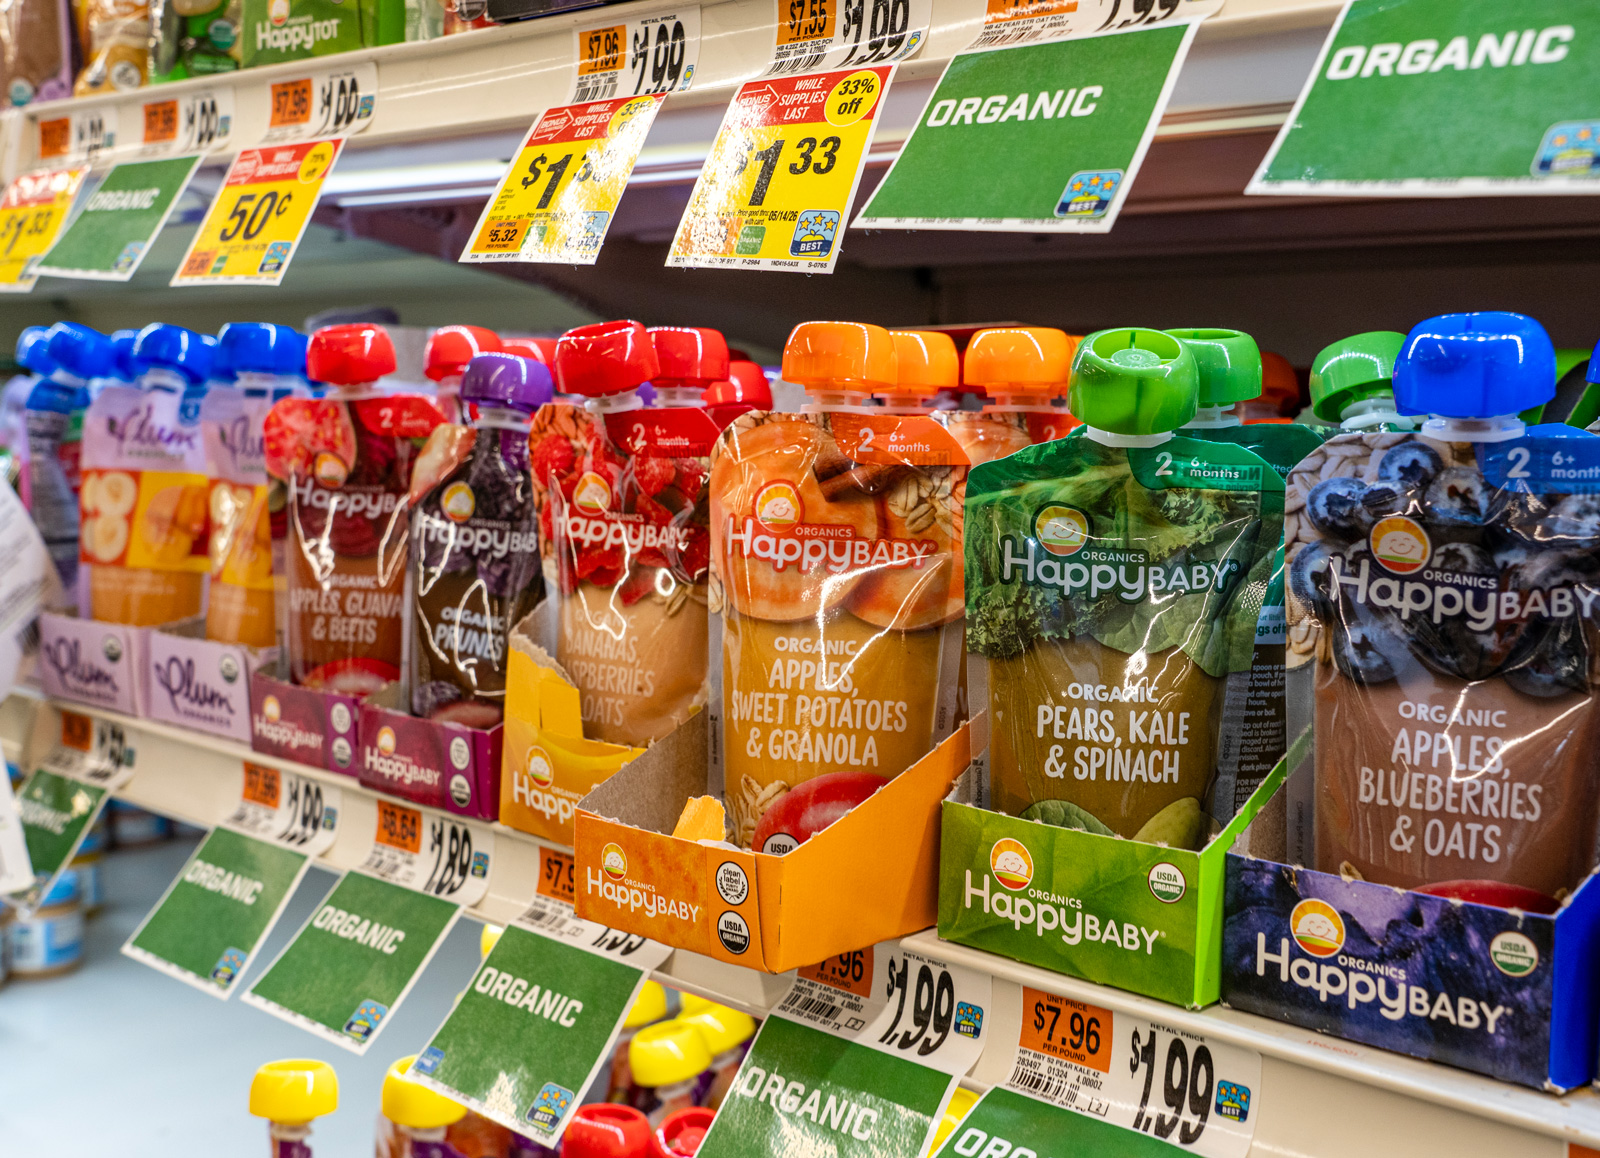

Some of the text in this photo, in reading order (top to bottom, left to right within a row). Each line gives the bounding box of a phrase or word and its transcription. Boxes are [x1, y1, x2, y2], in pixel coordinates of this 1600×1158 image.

[790, 0, 827, 36] $7.55
[256, 19, 339, 52] HappyTOT
[588, 32, 619, 68] $7.96
[632, 20, 685, 95] $1.99
[1326, 25, 1575, 80] ORGANIC
[794, 77, 826, 91] WHILE
[838, 78, 875, 96] 33%
[587, 102, 614, 114] WHILE
[779, 91, 827, 106] SUPPLIES
[837, 98, 863, 115] off
[926, 85, 1103, 127] ORGANIC
[572, 112, 612, 127] SUPPLIES
[783, 107, 810, 120] LAST
[574, 126, 597, 138] LAST
[86, 188, 160, 211] ORGANIC
[1068, 201, 1099, 213] BEST
[747, 209, 759, 217] good
[768, 210, 798, 222] 05/14/26
[488, 229, 518, 242] $5.32
[799, 242, 823, 252] BEST
[379, 407, 393, 428] 2
[633, 423, 647, 447] 2
[655, 425, 667, 436] 6+
[657, 436, 689, 446] months
[857, 427, 875, 452] 2
[889, 432, 906, 442] 6+
[888, 441, 930, 452] months
[1155, 452, 1173, 477] 2
[1190, 457, 1209, 467] 6+
[1507, 447, 1531, 478] 2
[1551, 451, 1575, 466] 6+
[1189, 468, 1239, 479] months
[795, 526, 852, 538] ORGANICS
[727, 516, 929, 573] HappyBABY
[1081, 551, 1145, 563] ORGANICS
[1004, 539, 1231, 600] HappyBABY
[1423, 569, 1497, 589] ORGANICS
[1330, 556, 1600, 631] HappyBABY
[311, 618, 377, 645] & BEETS
[435, 624, 504, 661] PRUNES
[774, 636, 857, 656] ORGANIC
[154, 656, 235, 715] Plum
[768, 658, 858, 698] APPLES,
[1067, 682, 1159, 704] ORGANIC
[582, 694, 624, 727] OATS
[731, 689, 789, 724] SWEET
[795, 695, 907, 733] POTATOES
[1398, 701, 1507, 728] ORGANIC
[253, 713, 324, 749] HappyBABY
[1037, 705, 1190, 748] PEARS, KALE
[746, 727, 763, 759] &
[768, 728, 878, 767] GRANOLA
[1391, 728, 1511, 780] APPLES,
[364, 745, 441, 786] HappyBABY
[1044, 744, 1180, 784] & SPINACH
[1359, 767, 1543, 822] BLUEBERRIES
[383, 809, 416, 841] $8.64
[1389, 815, 1502, 863] & OATS
[183, 859, 263, 905] ORGANIC
[722, 867, 741, 876] clean
[723, 875, 741, 885] label
[1156, 871, 1178, 884] USDA
[587, 866, 699, 923] HappyBABY
[624, 878, 656, 893] ORGANICS
[1153, 882, 1181, 895] ORGANIC
[1028, 888, 1082, 909] ORGANICS
[965, 869, 1160, 955] HappyBABY
[312, 904, 405, 955] ORGANIC
[724, 919, 743, 933] USDA
[722, 931, 746, 945] ORGANIC
[1500, 940, 1527, 954] USDA
[903, 952, 947, 969] RETAIL PRICE
[1338, 955, 1406, 980] ORGANICS
[1495, 952, 1531, 967] ORGANIC
[816, 972, 851, 989] PER POUND
[1256, 932, 1504, 1034] HappyBABY
[474, 966, 583, 1028] ORGANIC
[878, 956, 954, 1056] $1.99
[1046, 994, 1088, 1012] UNIT PRICE
[832, 1022, 842, 1031] TX
[960, 1025, 974, 1034] BEST
[1034, 1000, 1100, 1055] $7.96
[1150, 1023, 1205, 1042] RETAIL PRICE
[1019, 1048, 1090, 1075] HPY BBY PEAR KALE
[1042, 1043, 1086, 1062] PER POUND
[1017, 1056, 1068, 1079] 283497 01324
[1130, 1026, 1214, 1145] $1.99
[741, 1066, 878, 1142] ORGANIC
[1095, 1102, 1102, 1112] 2
[1221, 1106, 1240, 1116] BEST
[533, 1111, 554, 1123] BEST
